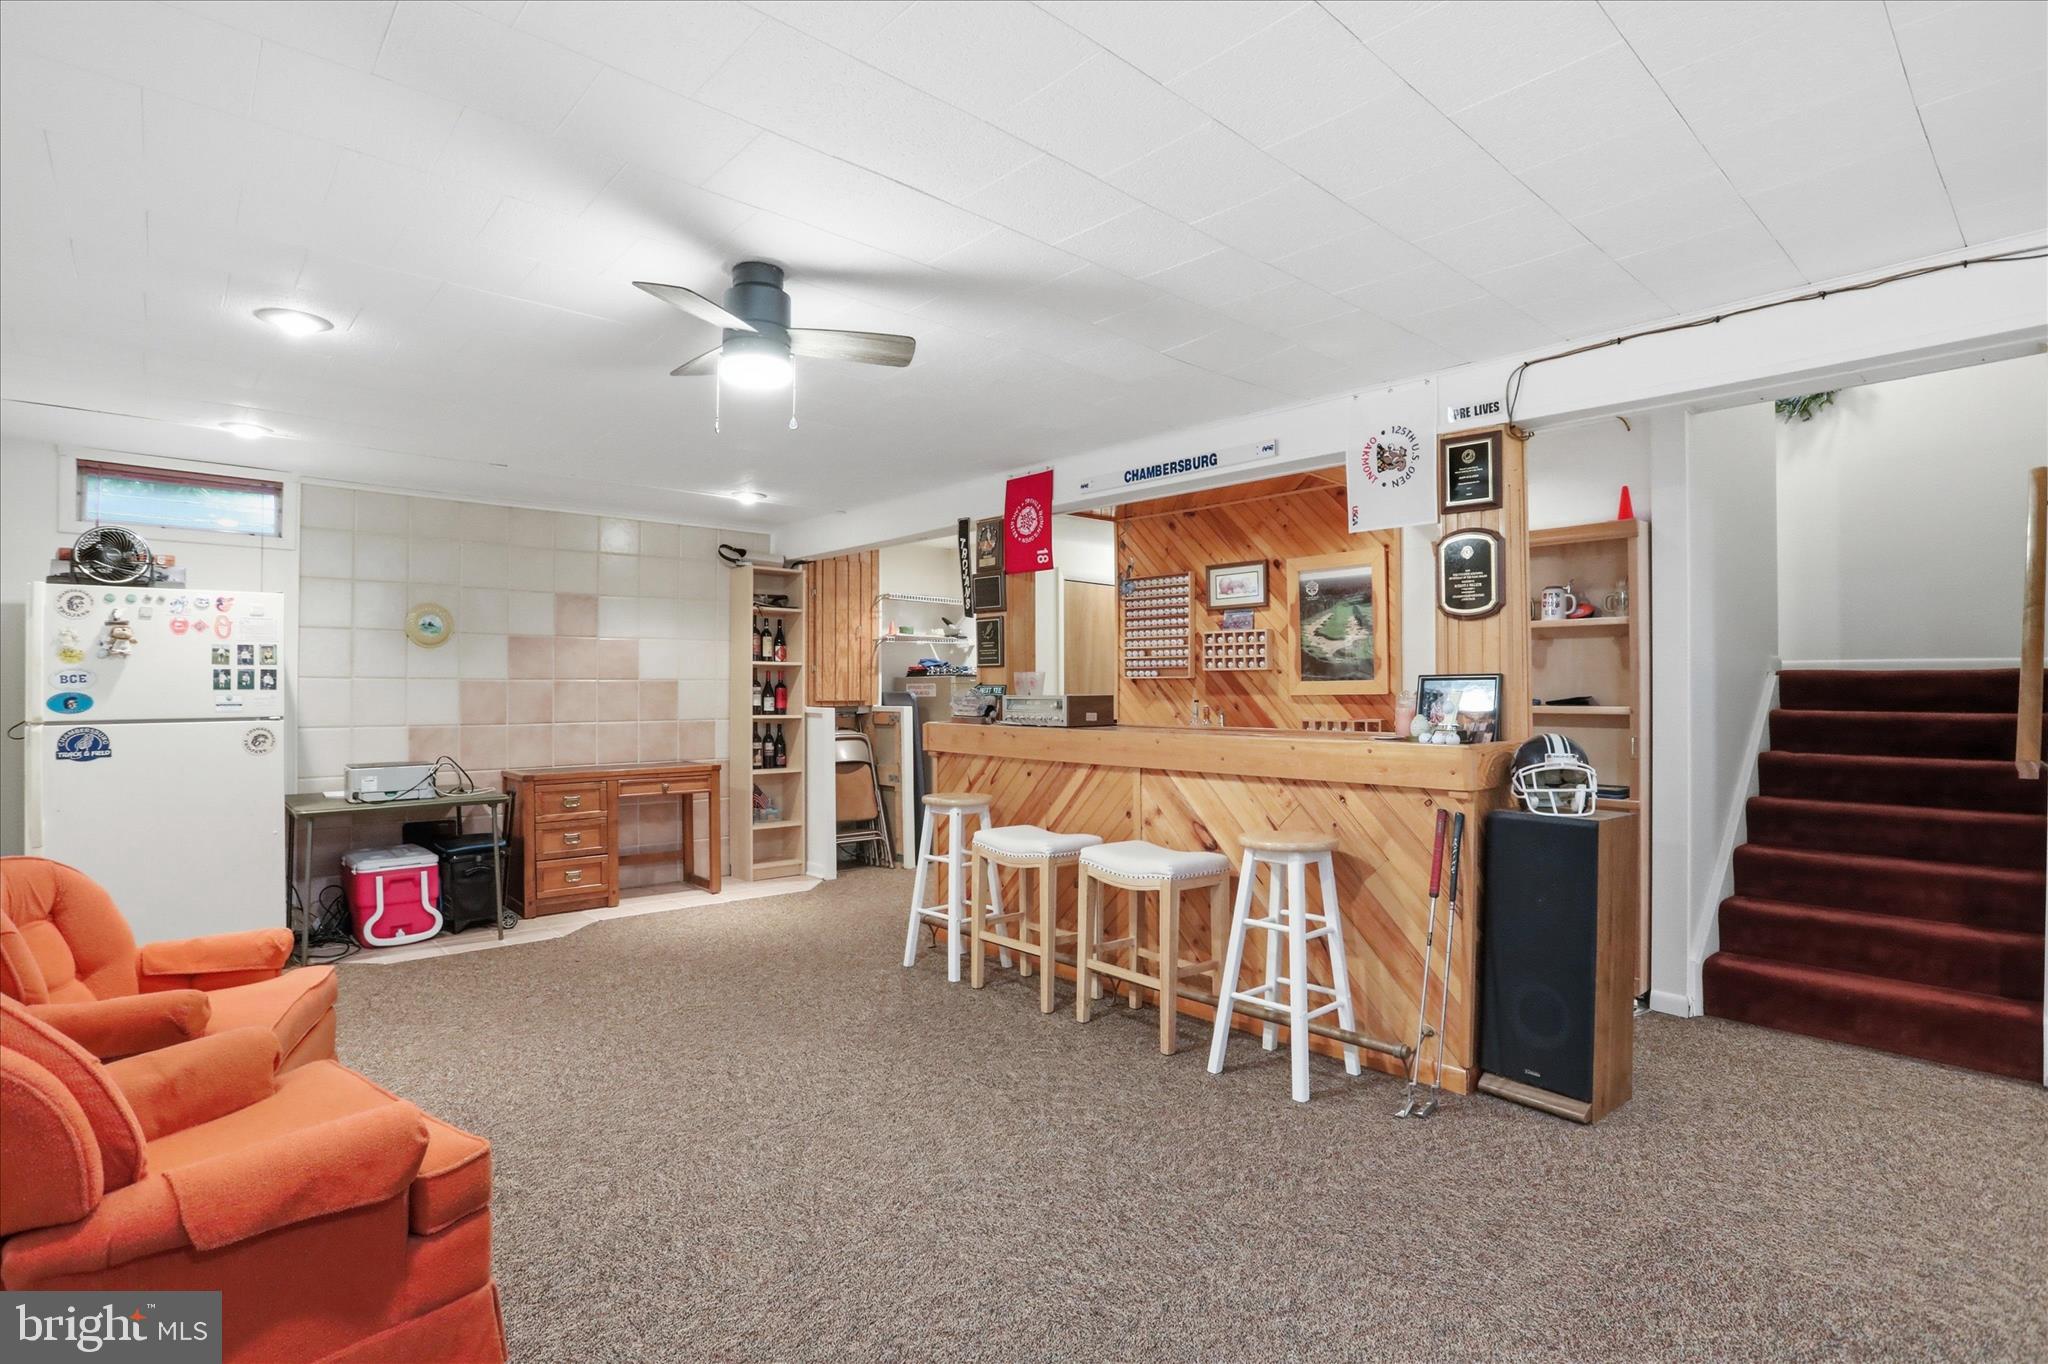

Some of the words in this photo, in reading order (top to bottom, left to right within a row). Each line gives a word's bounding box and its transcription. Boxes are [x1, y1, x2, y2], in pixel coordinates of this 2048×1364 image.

[1474, 401, 1500, 416] LIVES
[1392, 426, 1416, 443] 125TH
[1361, 437, 1378, 484] OAKMONT
[1411, 443, 1420, 464] U.S.
[1124, 453, 1218, 483] CHAMBERSBURG
[1391, 466, 1416, 488] OPEN
[1037, 547, 1049, 564] 18
[959, 537, 971, 610] TROJANS
[59, 674, 87, 684] BCE
